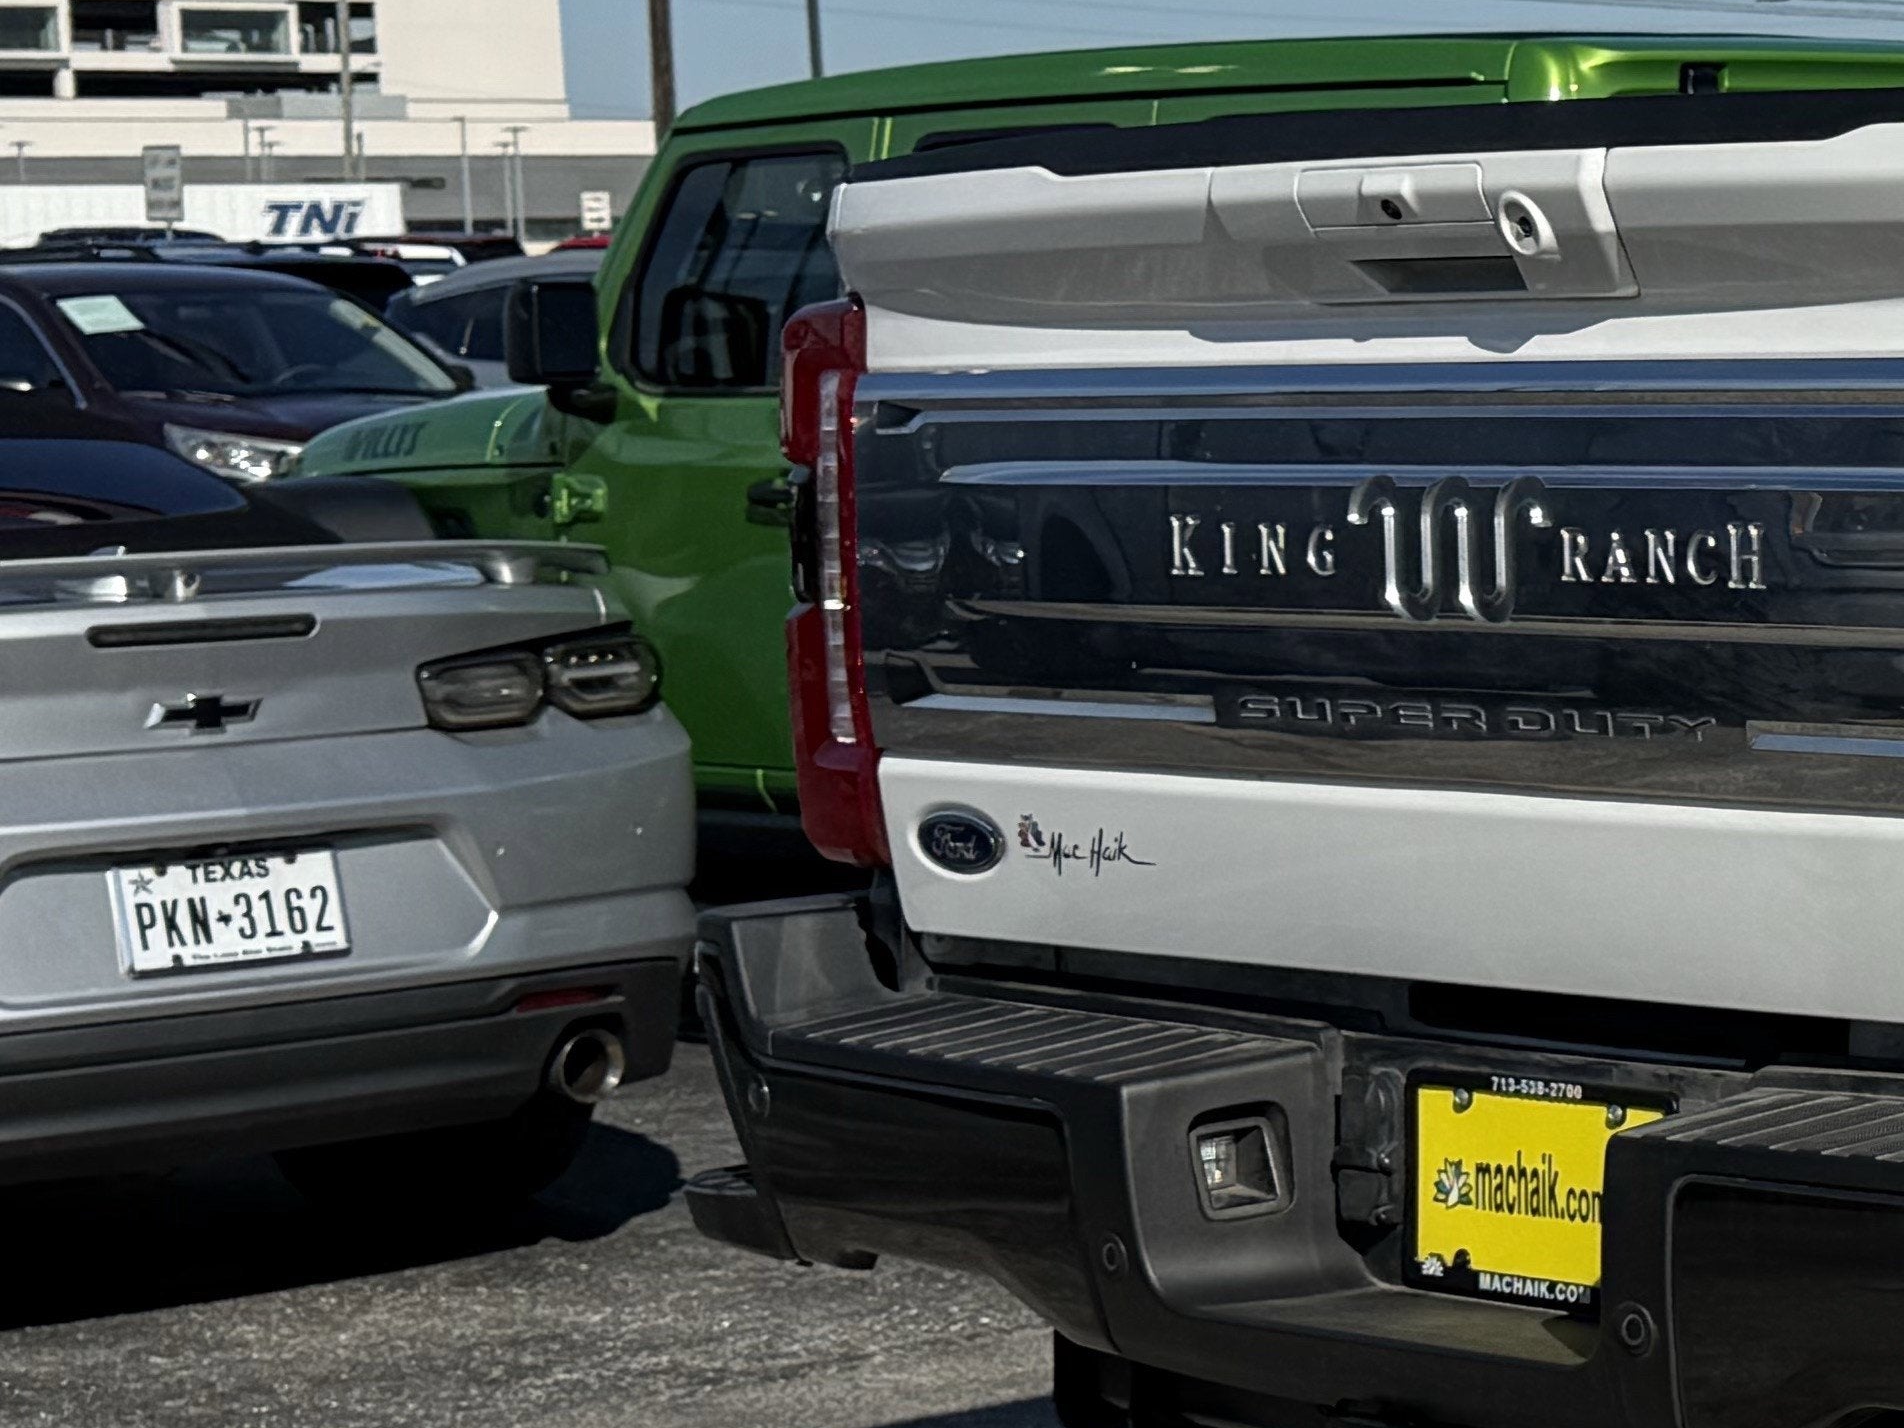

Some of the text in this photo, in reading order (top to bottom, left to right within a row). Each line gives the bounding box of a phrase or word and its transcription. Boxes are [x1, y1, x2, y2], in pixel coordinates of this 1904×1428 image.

[1168, 512, 1768, 591] KING RANCH
[1237, 694, 1717, 743] SUPER DUTY
[932, 823, 979, 862] Ford
[184, 857, 270, 885] TEXAS
[1490, 1075, 1583, 1100] 713-538-2700
[1478, 1272, 1591, 1305] MACHAIK.COM
